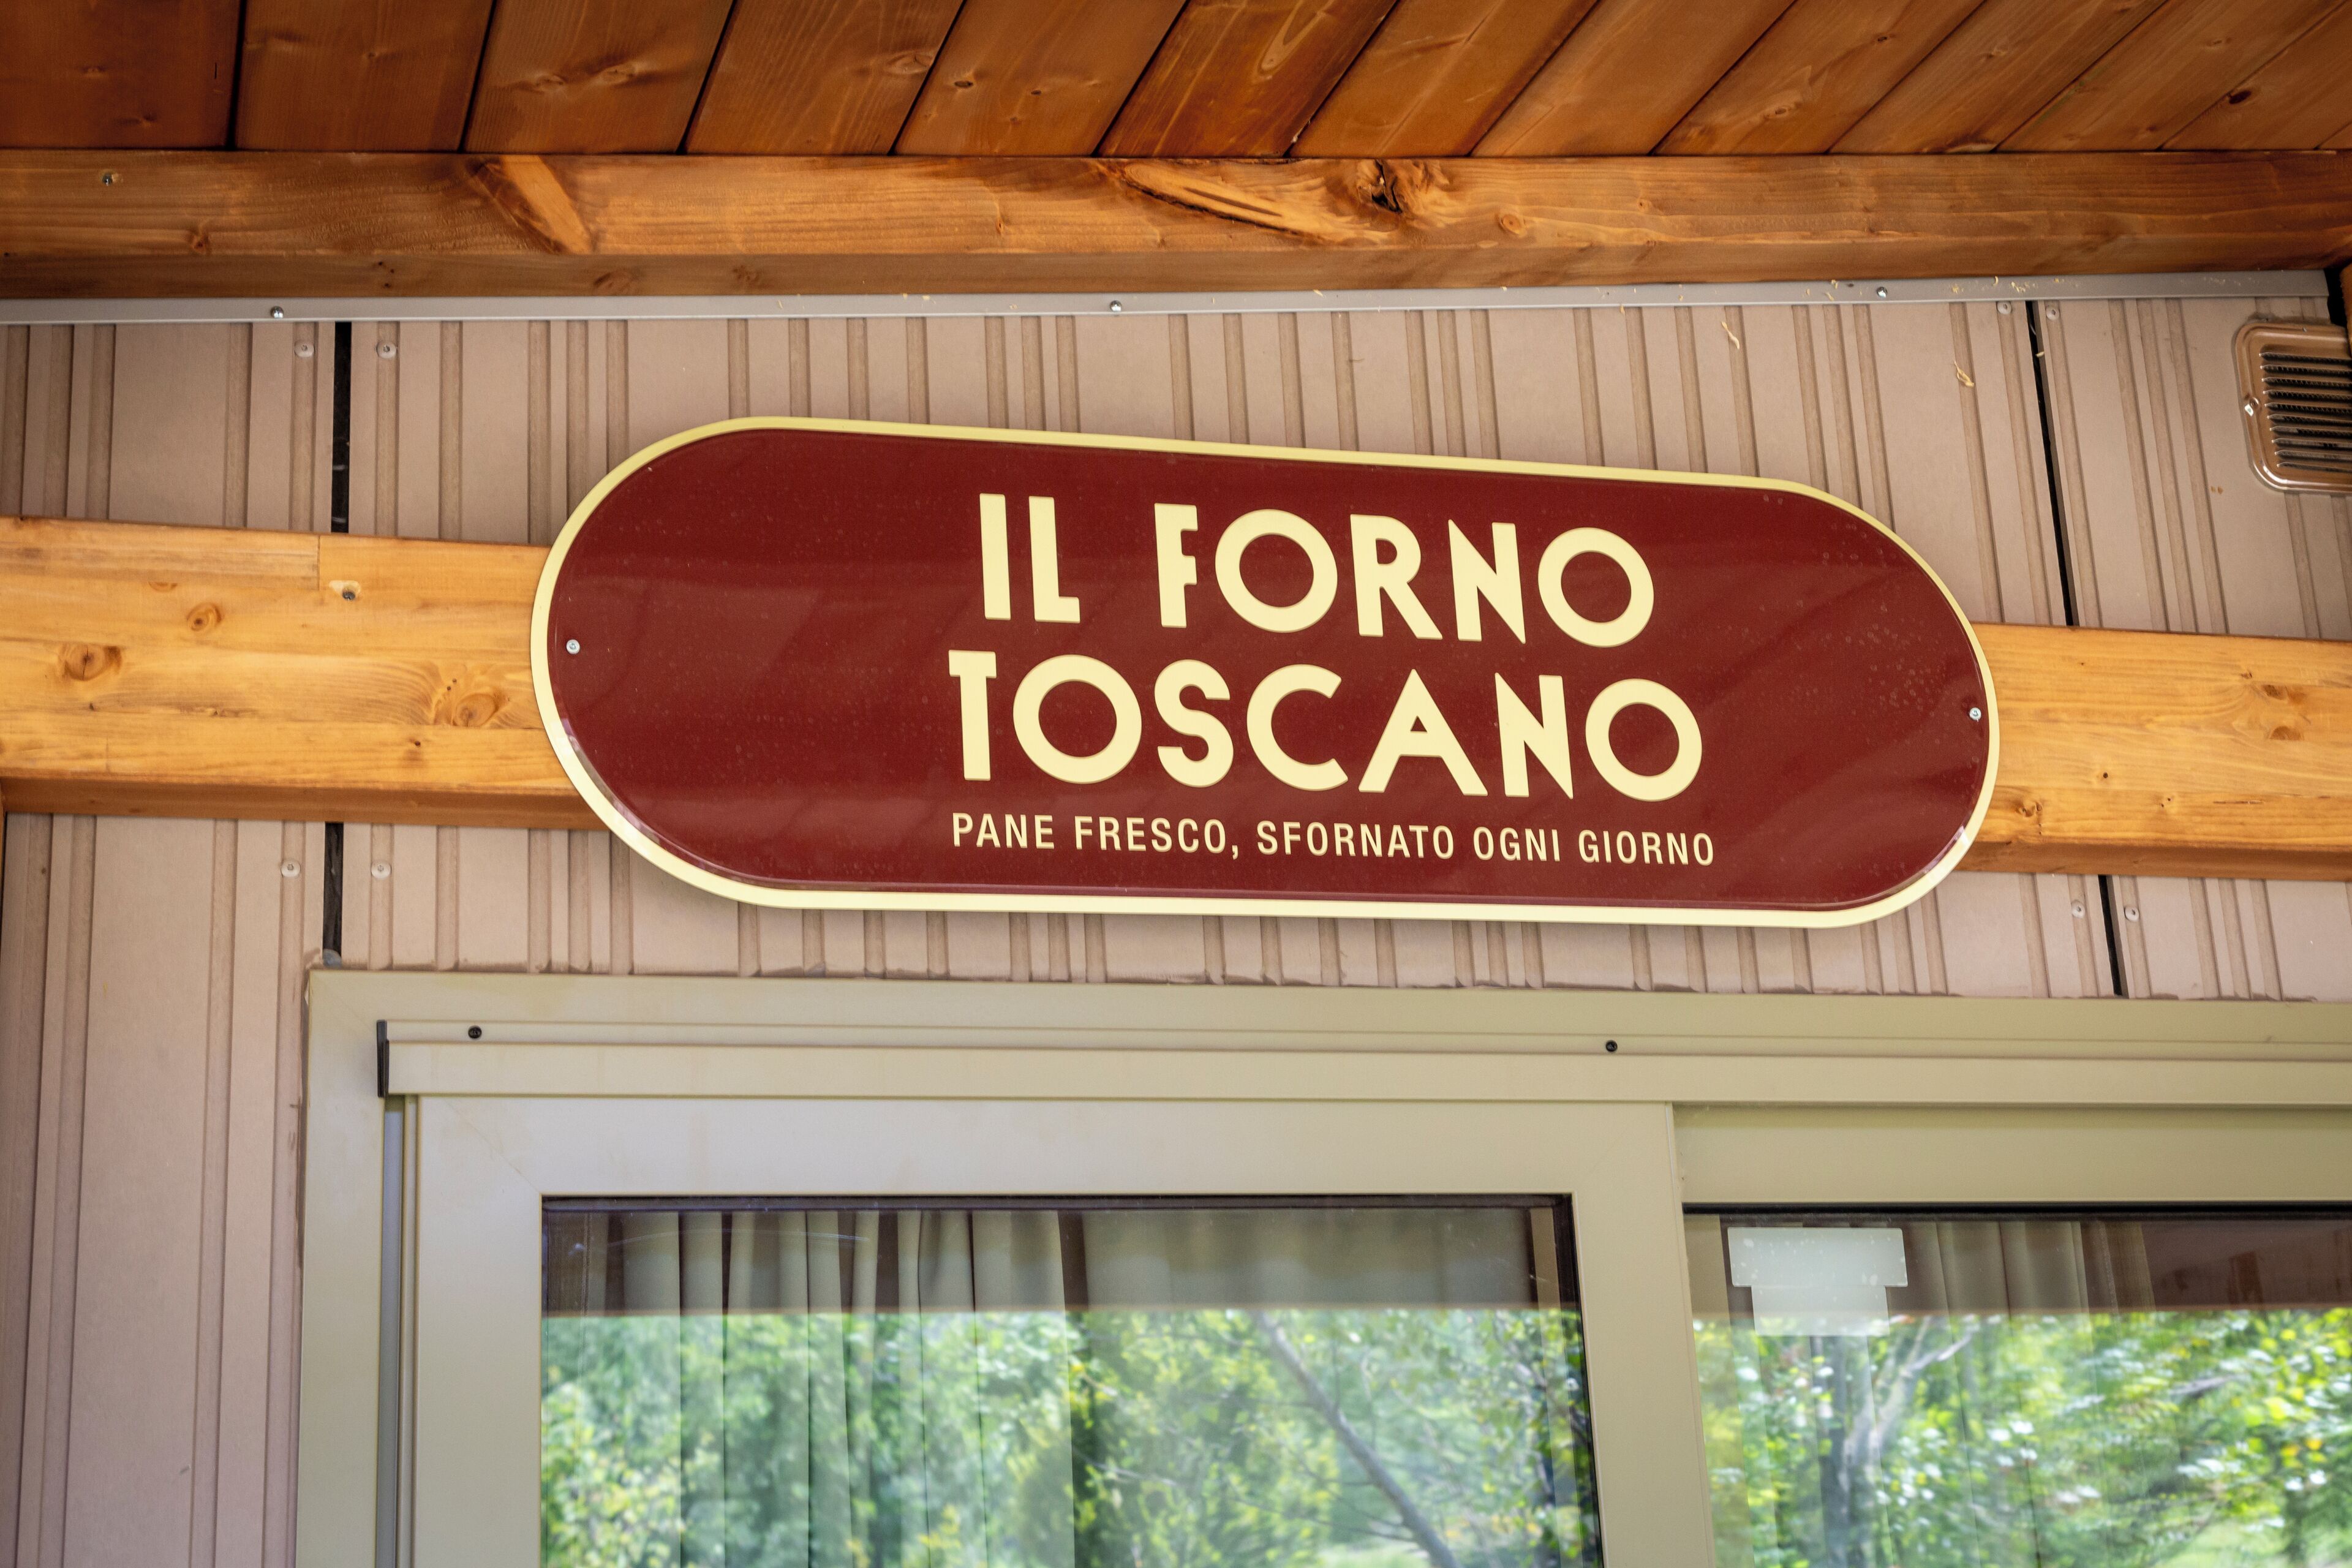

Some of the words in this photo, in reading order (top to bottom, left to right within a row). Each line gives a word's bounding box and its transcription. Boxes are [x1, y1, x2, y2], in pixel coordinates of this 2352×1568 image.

[979, 492, 1081, 624] IL
[1153, 502, 1655, 649] FORNO
[948, 649, 1703, 802] TOSCANO
[952, 812, 1055, 850] PANE
[1074, 815, 1239, 861] FRESCO,
[1256, 820, 1455, 860] SFORNATO
[1472, 826, 1561, 862] OGNI
[1578, 829, 1714, 867] GIORNO
